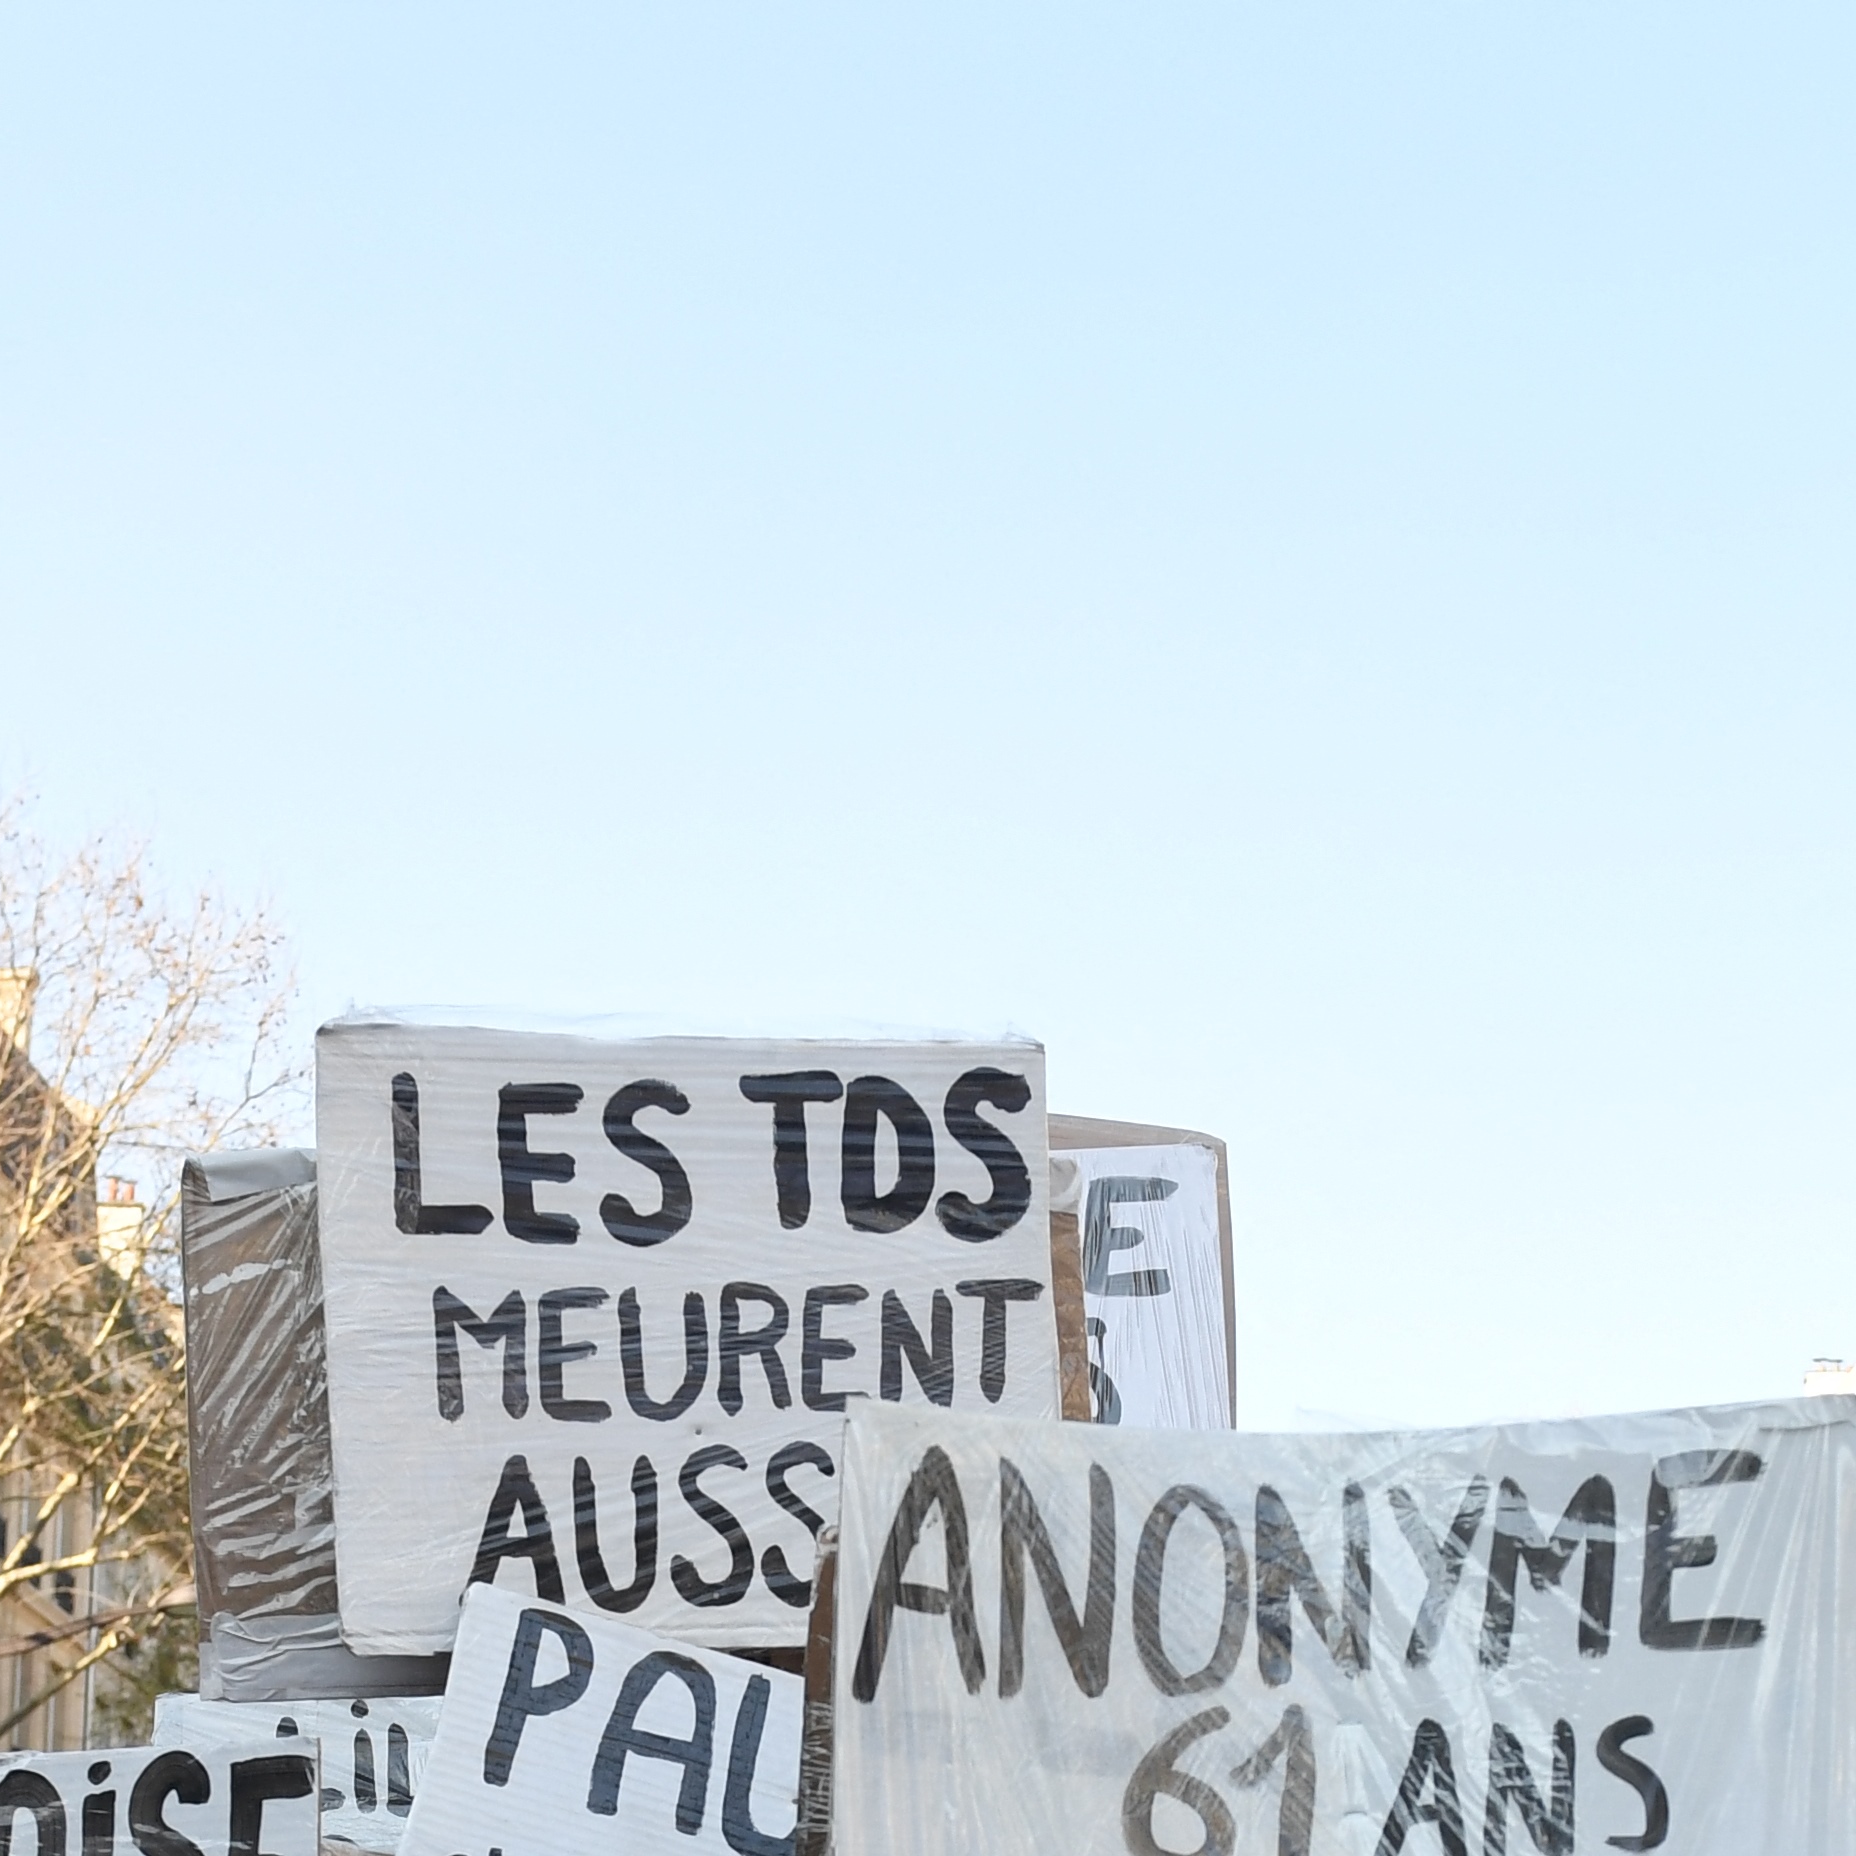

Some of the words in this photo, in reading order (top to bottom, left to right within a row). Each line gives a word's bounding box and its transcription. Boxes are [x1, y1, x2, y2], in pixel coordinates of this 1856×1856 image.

[389, 1070, 694, 1247] LES
[739, 1066, 1032, 1243] TDS
[431, 1277, 1044, 1424] MEURENT
[465, 1440, 838, 1613] AUSS
[850, 1444, 1767, 1702] ANONYME
